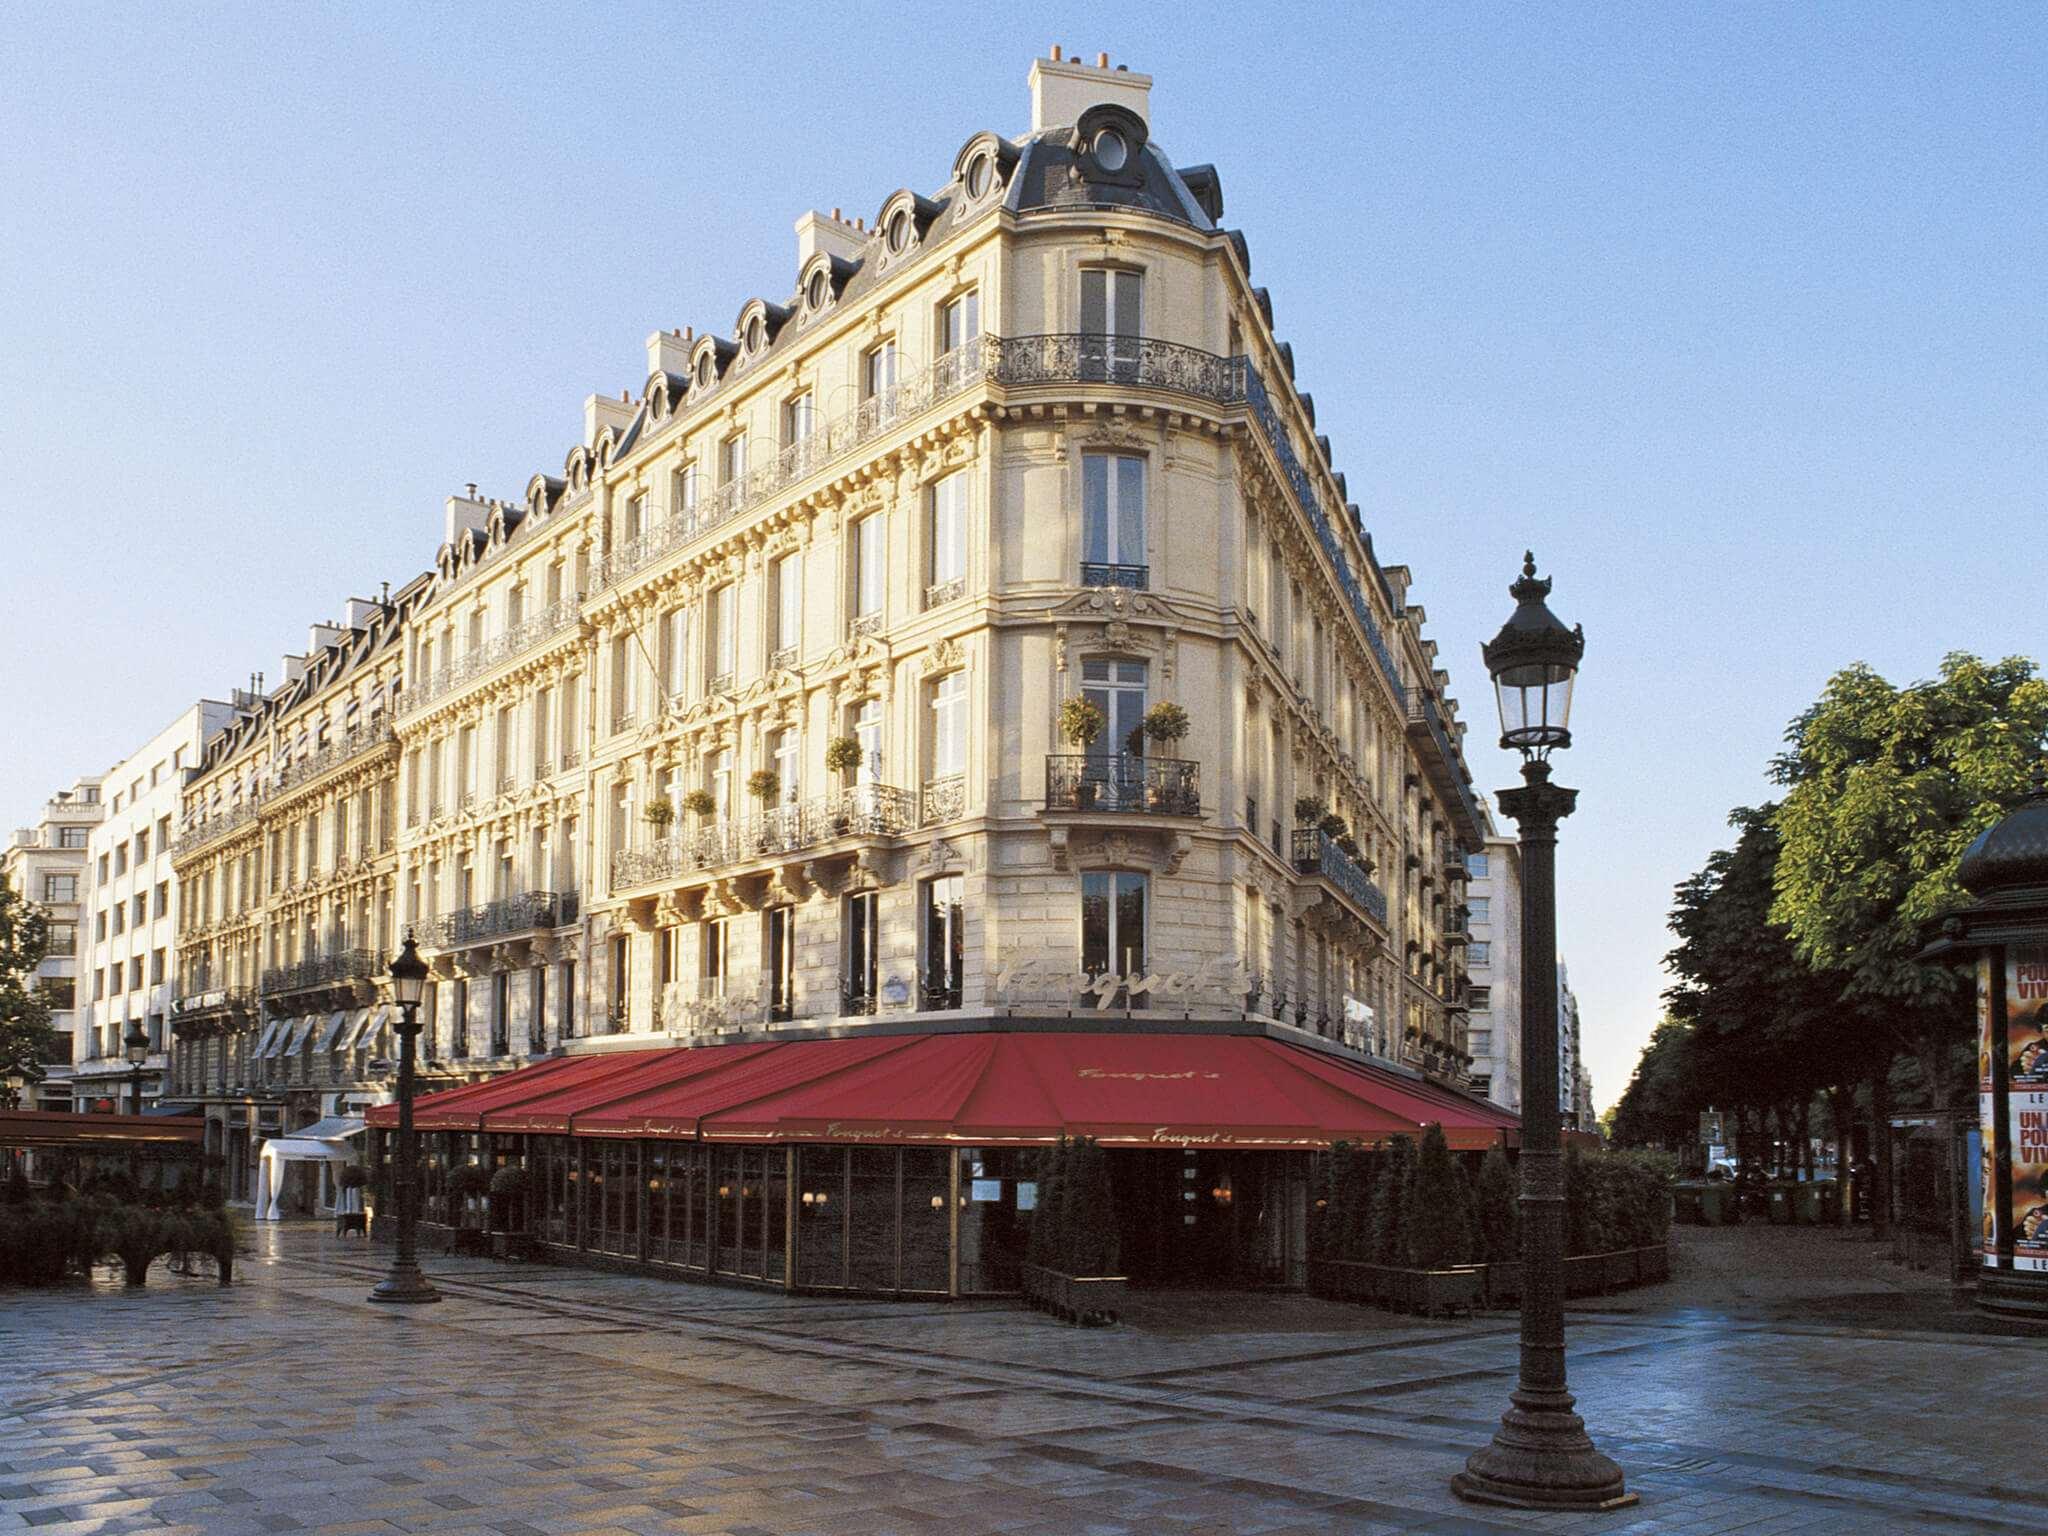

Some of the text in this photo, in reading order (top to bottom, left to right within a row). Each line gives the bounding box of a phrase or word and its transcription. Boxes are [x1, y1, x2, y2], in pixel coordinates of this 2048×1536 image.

[2030, 1094, 2044, 1103] LE
[2020, 1112, 2042, 1128] UN
[1152, 1126, 1232, 1147] Fouquet's
